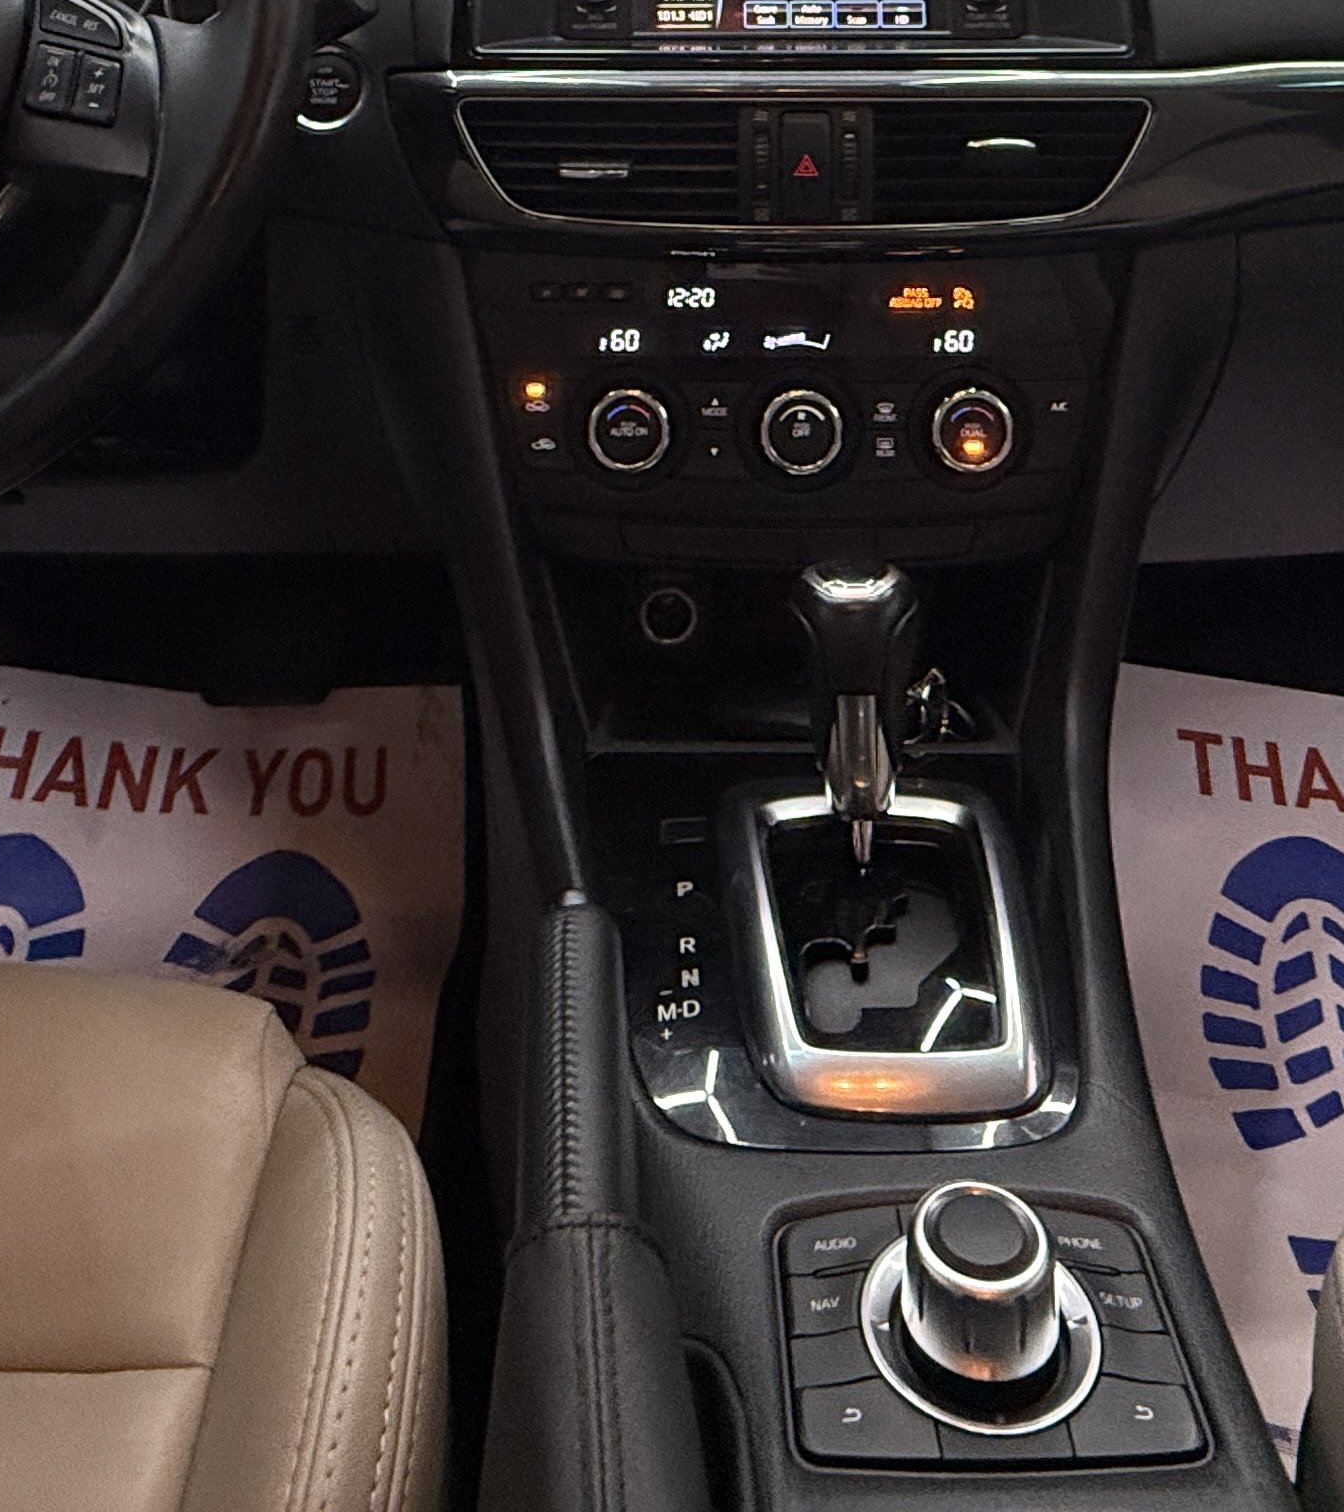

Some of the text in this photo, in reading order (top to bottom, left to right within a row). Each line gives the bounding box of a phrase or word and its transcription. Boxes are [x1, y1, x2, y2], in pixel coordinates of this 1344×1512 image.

[794, 15, 829, 26] Memory
[667, 287, 716, 308] 12:20
[903, 287, 929, 297] PASS
[701, 407, 728, 416] MODE
[610, 427, 648, 437] AUTO ON
[960, 429, 986, 438] DUAL
[244, 745, 389, 818] YOU
[676, 881, 694, 897] P
[679, 937, 697, 954] R
[681, 968, 700, 989] N
[814, 1236, 857, 1252] AUDIO
[1057, 1235, 1104, 1251] PHONE
[810, 1296, 841, 1312] NAV
[1099, 1291, 1144, 1311] SETUP
